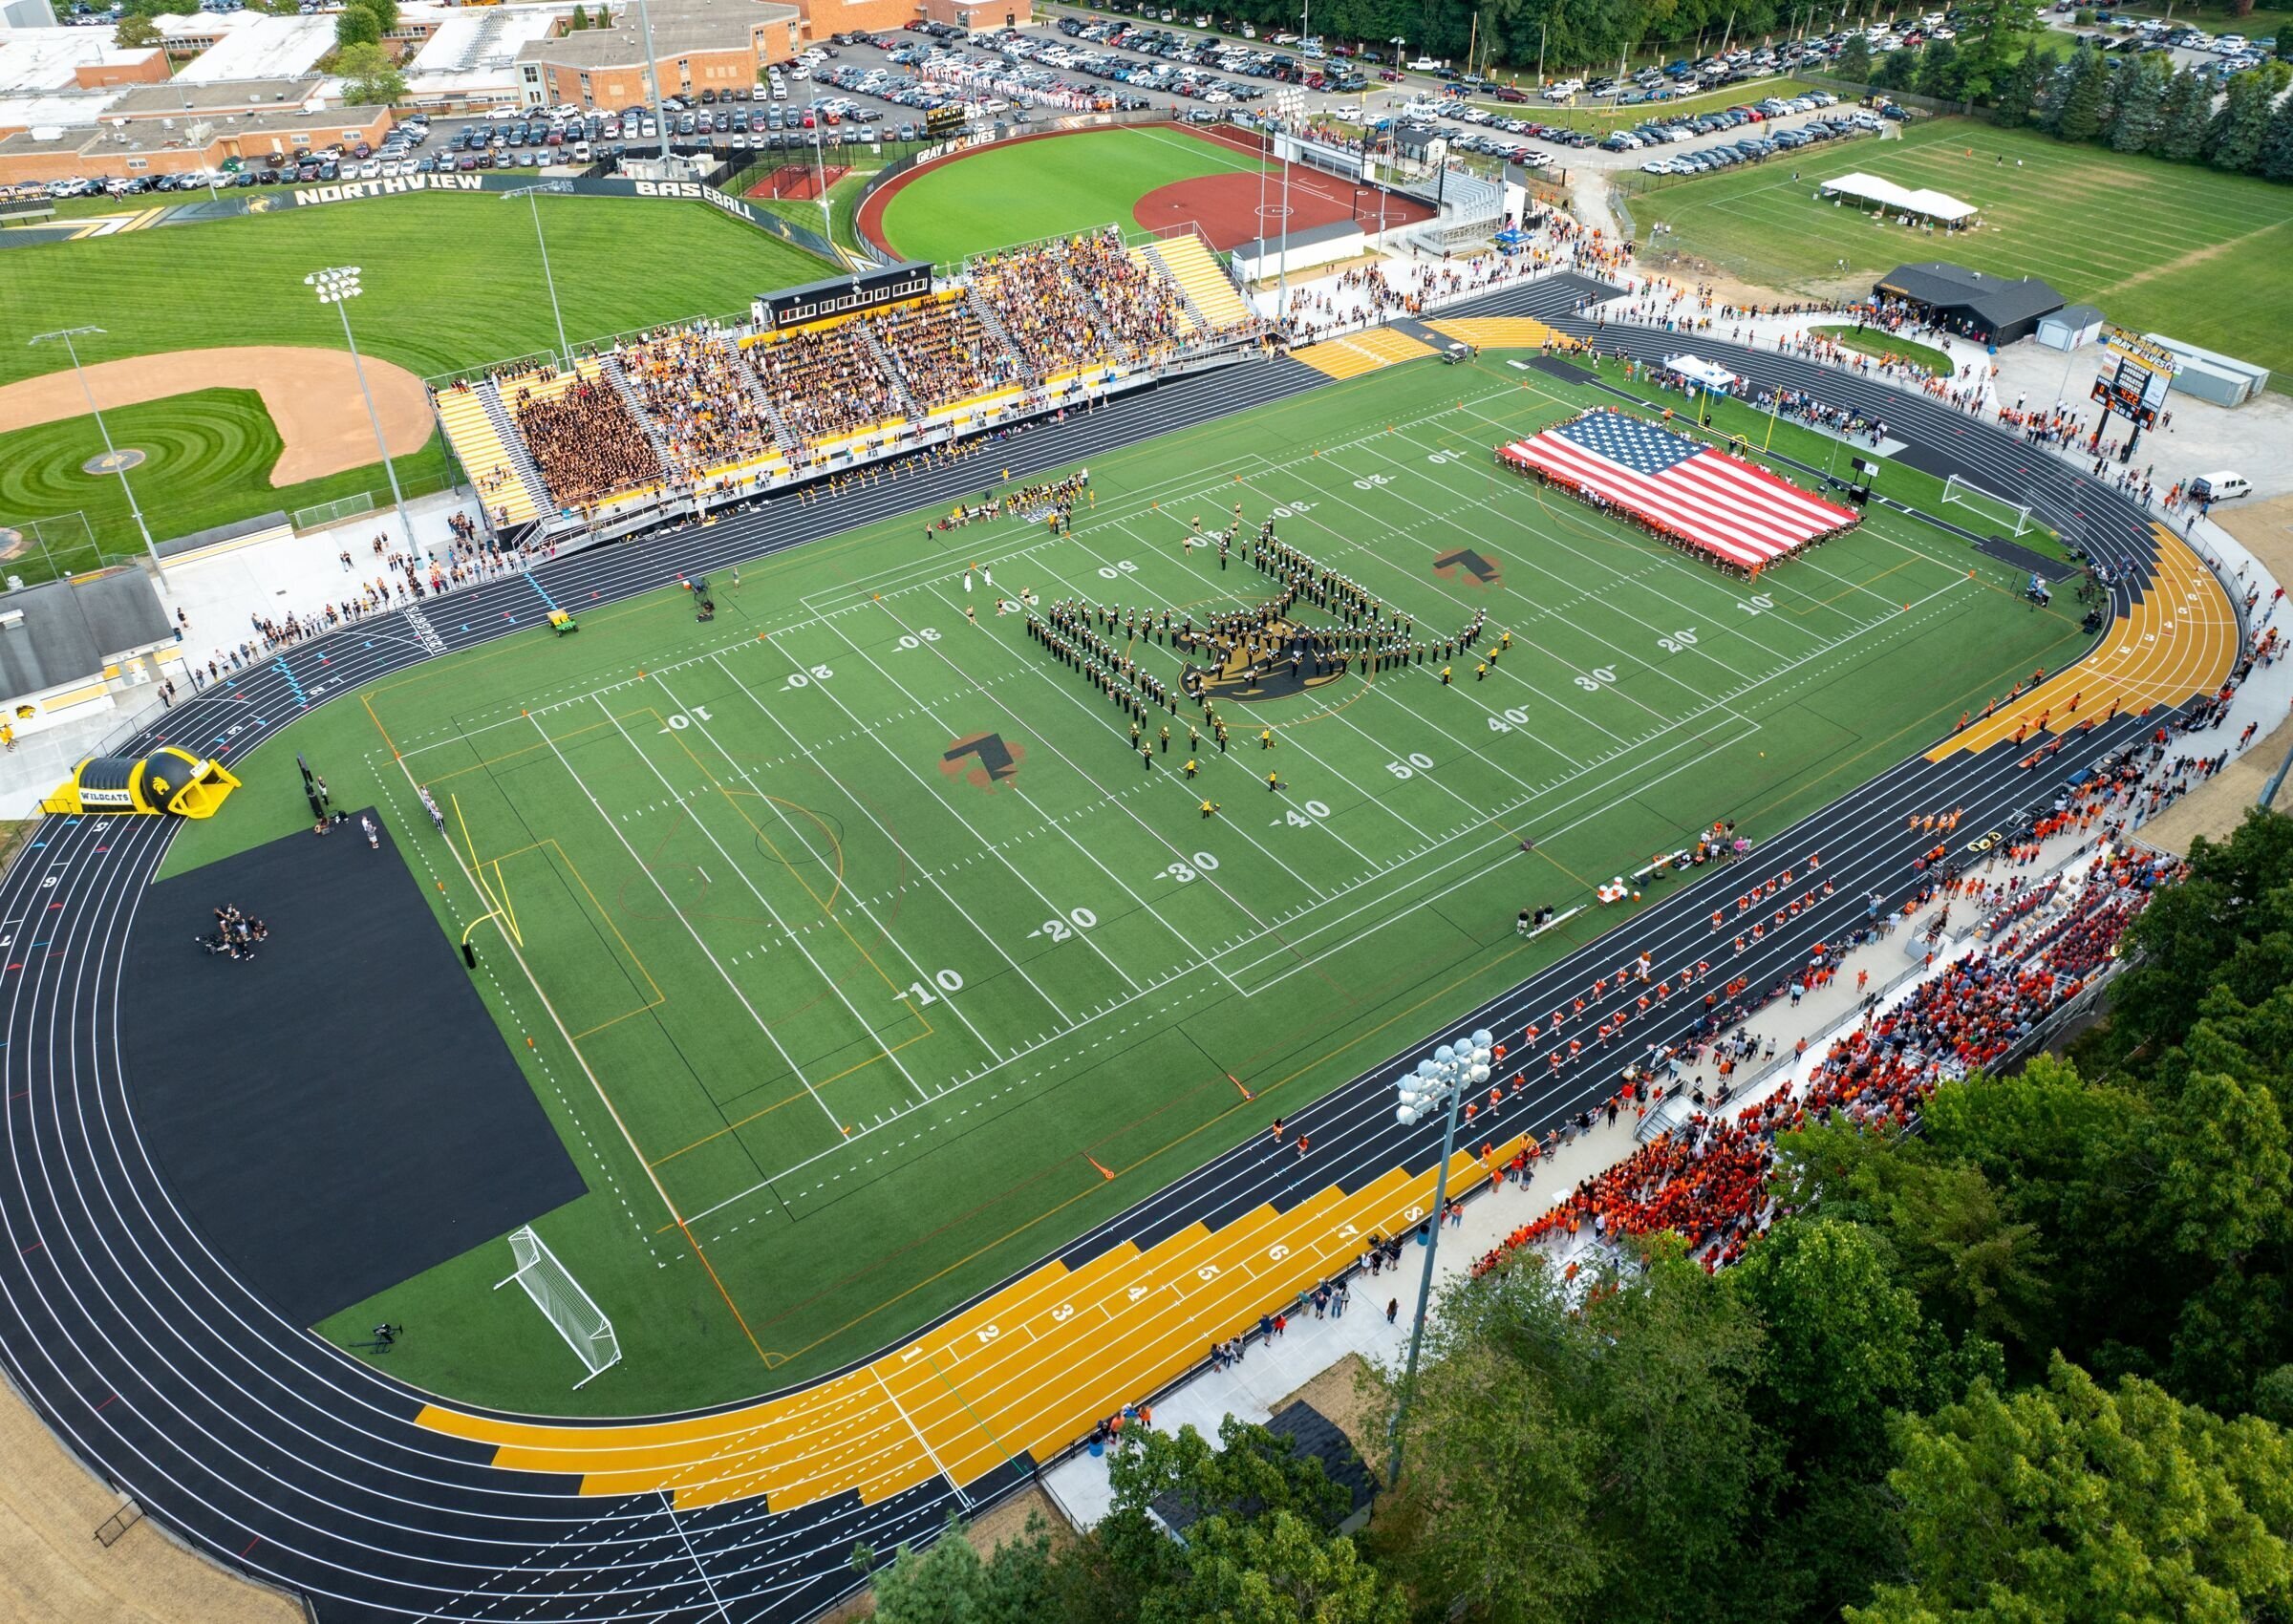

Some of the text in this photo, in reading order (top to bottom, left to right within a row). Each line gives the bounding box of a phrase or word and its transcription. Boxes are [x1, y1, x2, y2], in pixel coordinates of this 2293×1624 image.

[917, 144, 943, 164] GRAY
[294, 174, 482, 206] NORTHVIEW
[635, 181, 756, 222] BASEBALL
[2110, 335, 2132, 351] GRAY
[2120, 388, 2139, 405] 4:22
[1428, 449, 1459, 464] 10
[1353, 474, 1389, 490] 20
[1274, 502, 1310, 518] 30
[1099, 560, 1139, 579] 50
[1737, 596, 1774, 615] 10
[2187, 593, 2198, 601] 6
[899, 628, 942, 649] 30
[1657, 630, 1698, 653] 20
[788, 664, 834, 687] 20
[1574, 668, 1617, 691] 30
[668, 705, 713, 729] 10
[1488, 709, 1529, 733] 40
[1385, 753, 1434, 779] 50
[81, 792, 129, 801] WILDCATS
[1286, 801, 1331, 828] 40
[93, 822, 109, 832] 5
[1168, 852, 1219, 882] 30
[42, 876, 57, 888] 6
[1042, 908, 1097, 942] 20
[909, 969, 964, 1006] 10
[901, 1206, 1424, 1363] 1 2 3 4 5 6 7 8
